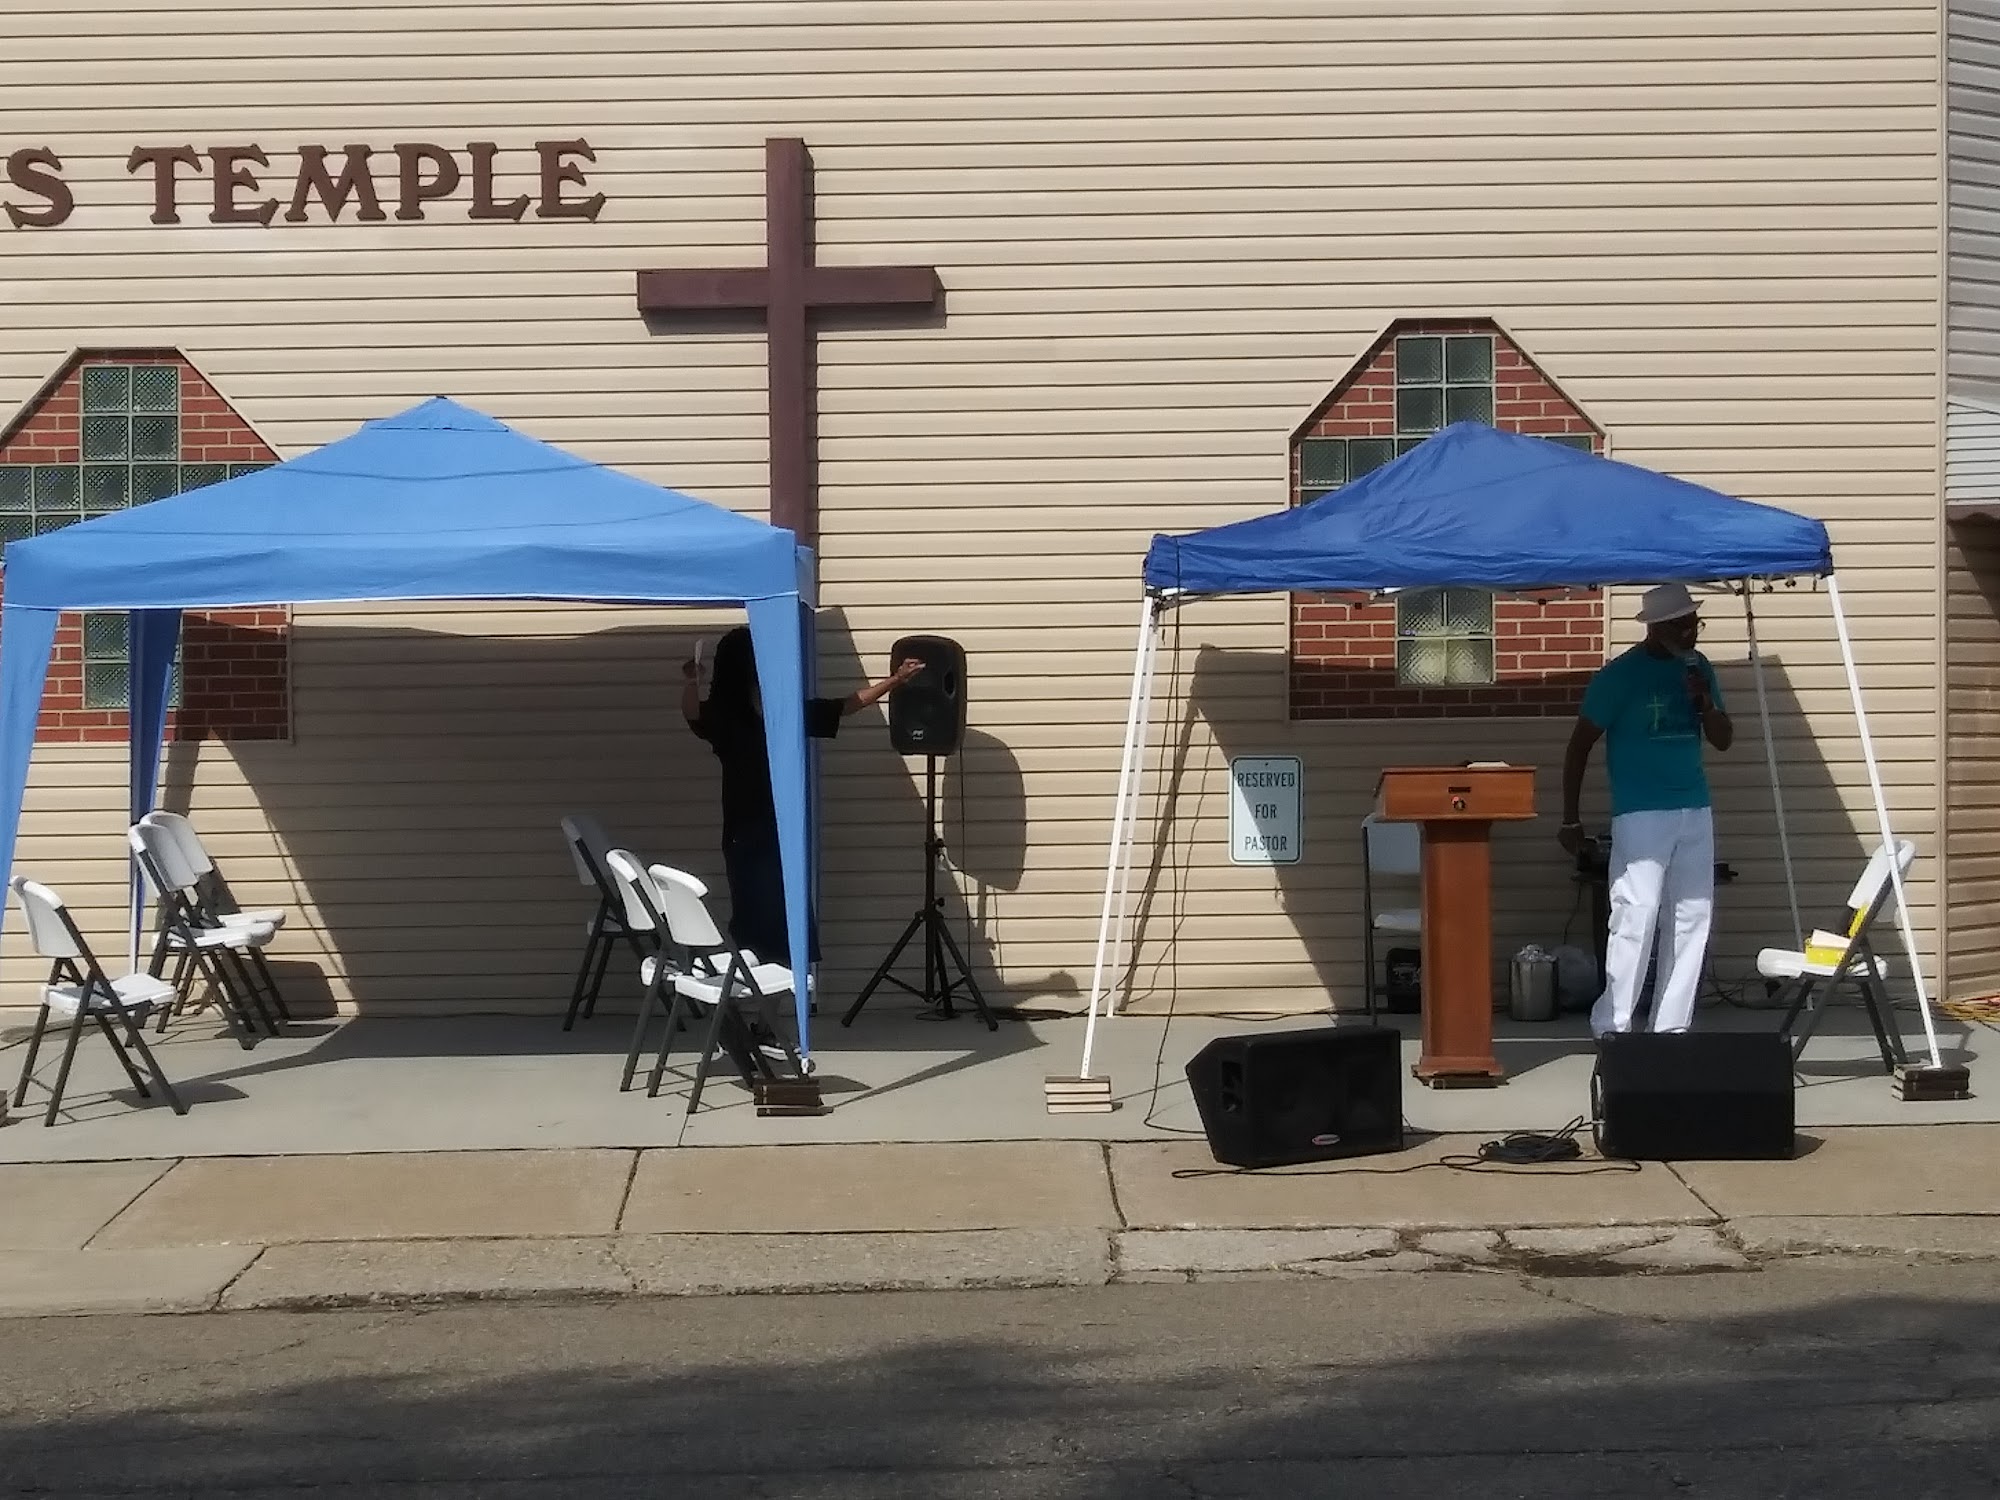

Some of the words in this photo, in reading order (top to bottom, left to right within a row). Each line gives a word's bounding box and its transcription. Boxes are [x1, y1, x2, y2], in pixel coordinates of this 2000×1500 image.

[3, 146, 75, 230] S
[127, 138, 607, 228] TEMPLE
[1237, 772, 1295, 788] RESERVED
[1255, 803, 1277, 819] FOR
[1244, 835, 1288, 851] PASTOR
